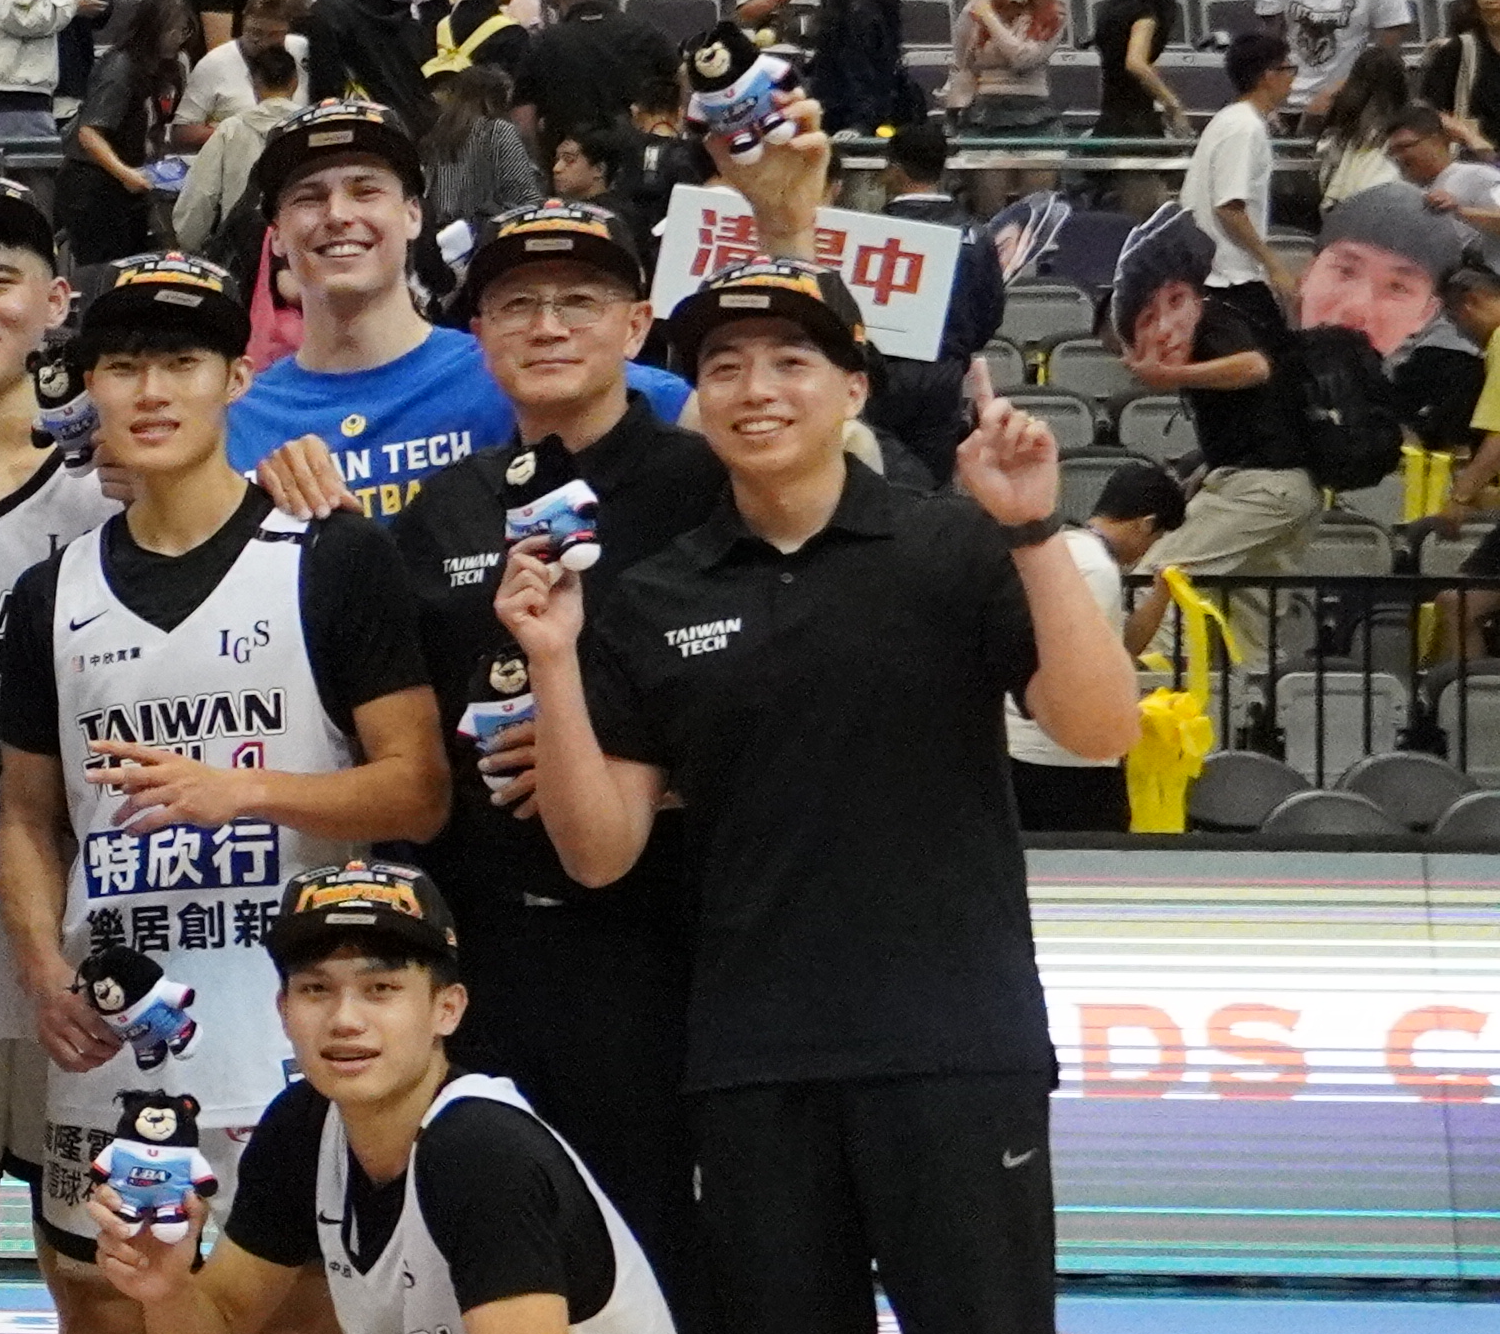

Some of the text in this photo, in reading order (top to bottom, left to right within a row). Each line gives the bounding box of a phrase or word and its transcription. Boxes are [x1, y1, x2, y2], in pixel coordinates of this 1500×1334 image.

[694, 208, 927, 306] 清中
[384, 429, 473, 475] TECH
[442, 552, 501, 574] TAIWAN
[449, 568, 485, 588] TECH
[218, 619, 271, 665] IGS
[664, 617, 742, 647] TAIWAN
[678, 634, 728, 658] TECH
[77, 688, 287, 743] TAIWAN
[88, 823, 276, 894] 特欣行
[87, 898, 281, 954] 樂居創新
